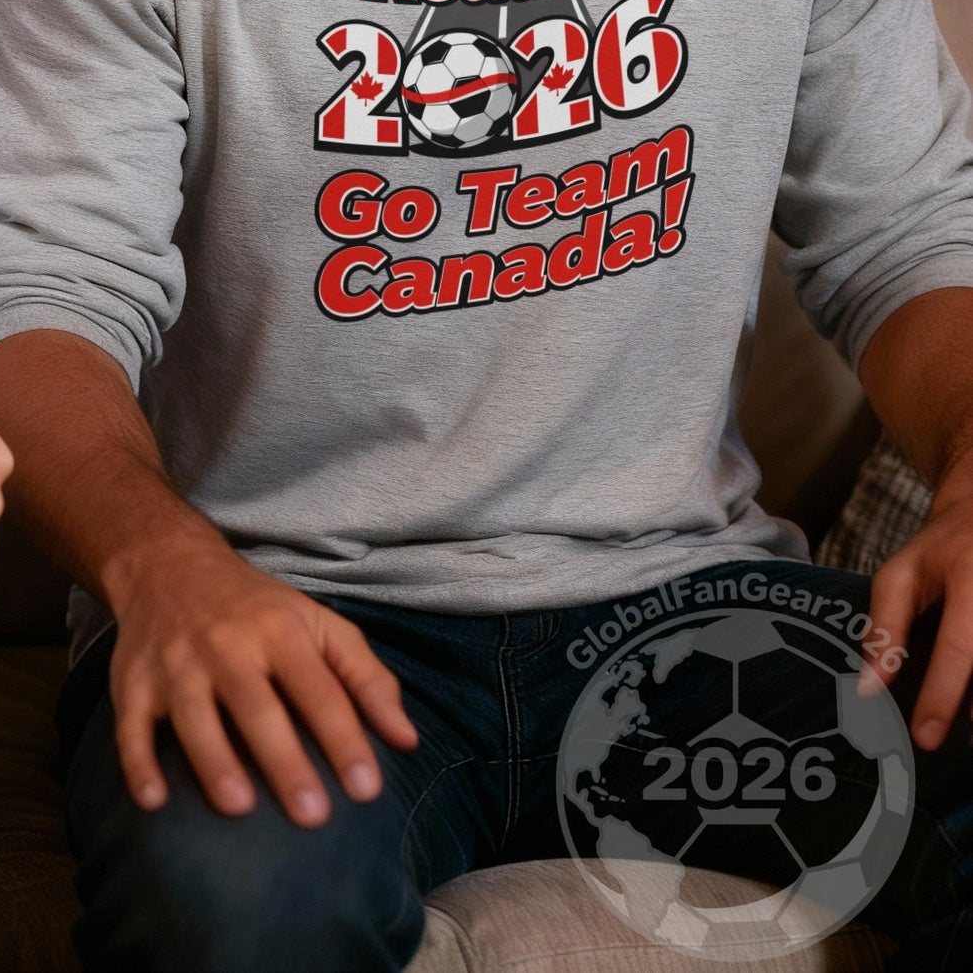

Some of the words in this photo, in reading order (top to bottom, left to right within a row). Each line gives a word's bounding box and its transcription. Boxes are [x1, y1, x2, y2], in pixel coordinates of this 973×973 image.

[314, 172, 695, 322] Canada!
[316, 169, 441, 241] Go
[456, 125, 694, 237] Team
